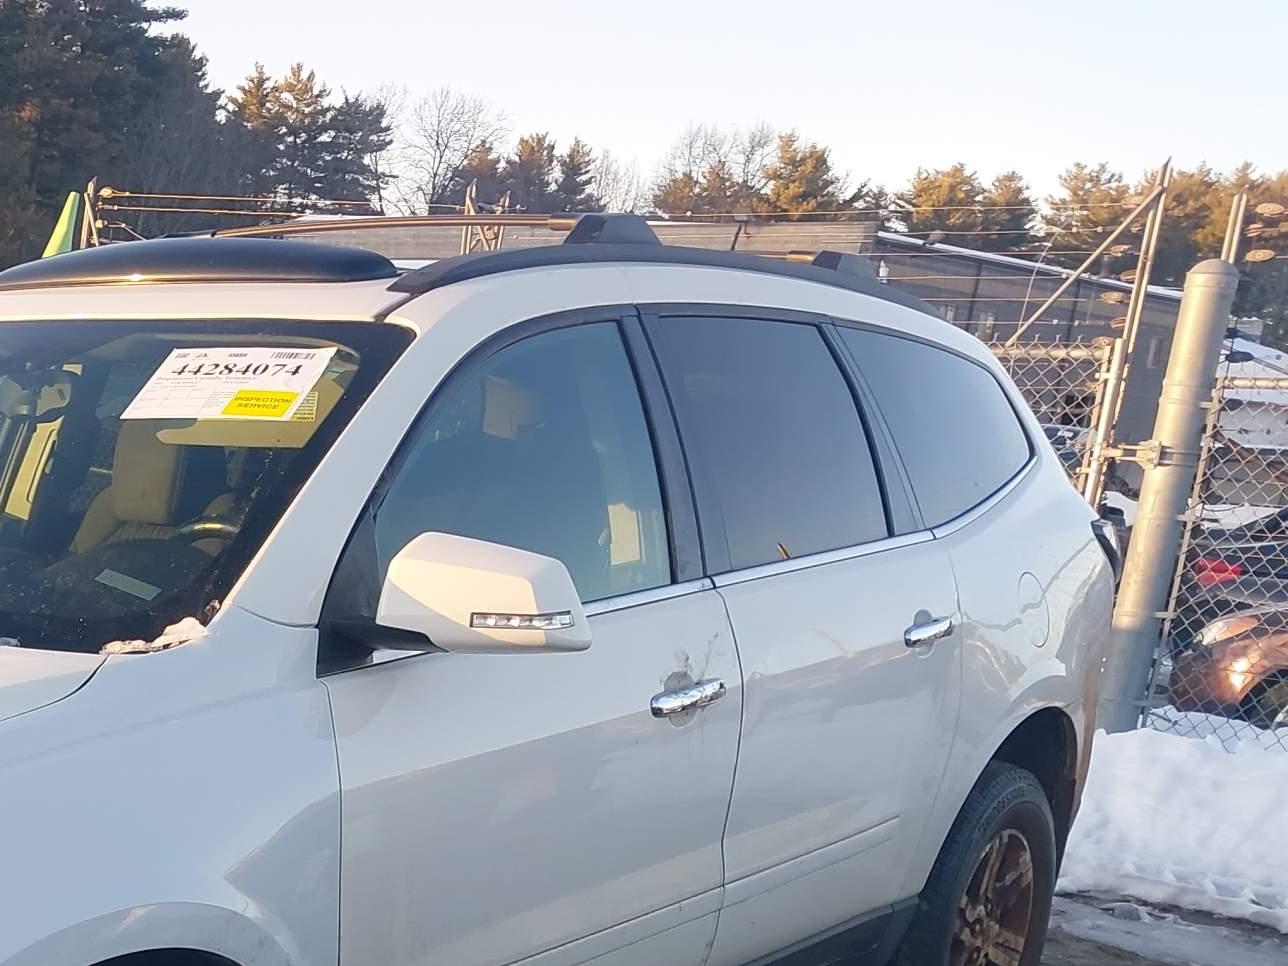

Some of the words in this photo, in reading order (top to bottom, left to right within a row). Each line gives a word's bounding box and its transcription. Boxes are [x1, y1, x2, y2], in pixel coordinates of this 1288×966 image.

[171, 361, 302, 377] 44284074
[234, 396, 292, 404] INSPECTION
[236, 402, 281, 410] SERVICE
